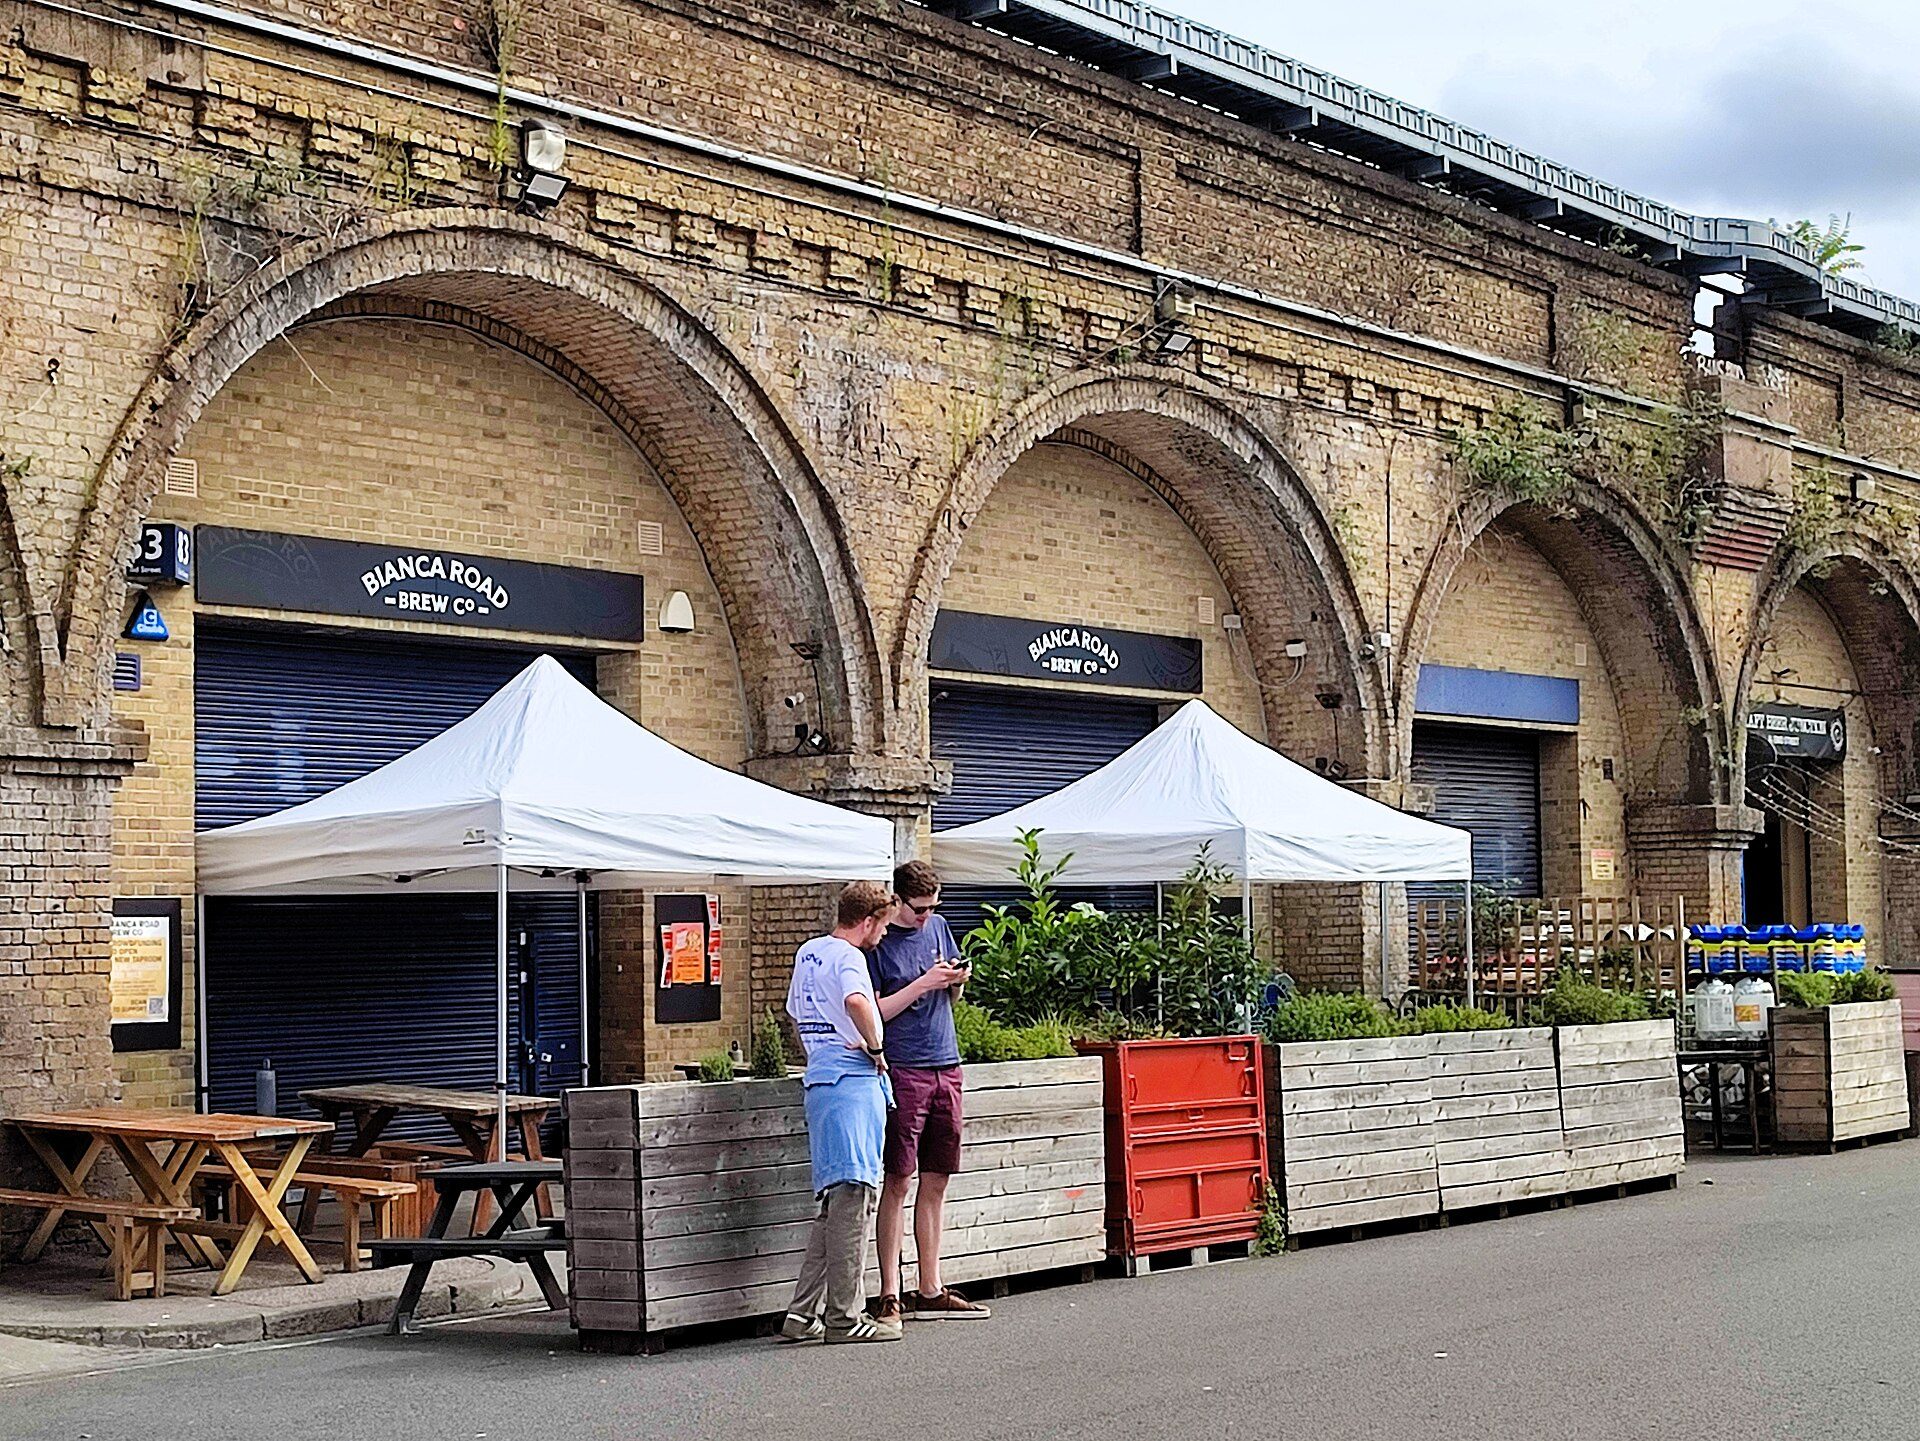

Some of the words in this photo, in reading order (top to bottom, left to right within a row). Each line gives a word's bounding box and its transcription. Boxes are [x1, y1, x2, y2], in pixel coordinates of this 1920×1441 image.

[361, 555, 447, 597] BIANCA
[449, 559, 509, 609] ROAD
[398, 591, 449, 613] BREW
[1028, 628, 1081, 662] BIANCA
[1081, 630, 1119, 669] ROAD
[1050, 656, 1082, 674] BREW
